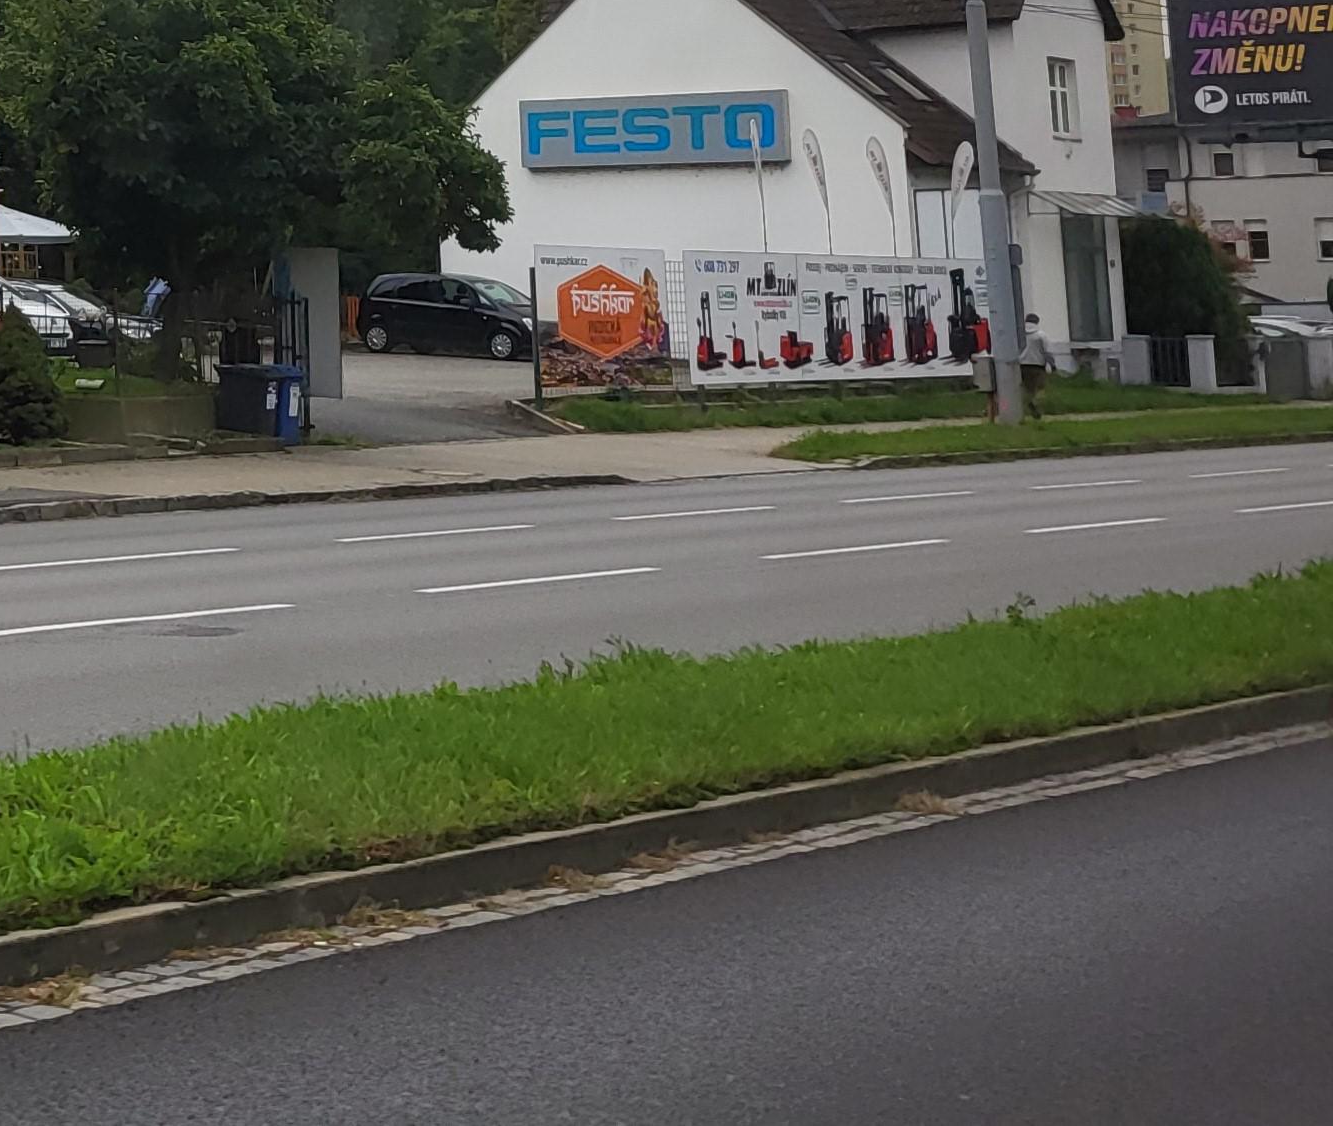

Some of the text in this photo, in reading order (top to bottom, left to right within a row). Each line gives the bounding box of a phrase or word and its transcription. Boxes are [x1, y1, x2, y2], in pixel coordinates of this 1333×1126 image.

[1190, 40, 1305, 76] ZMĚNU!
[1236, 92, 1269, 107] LETOS
[527, 103, 775, 155] FESTO
[540, 255, 588, 267] www.pushkar.cz
[746, 273, 796, 296] MT ZLÍN
